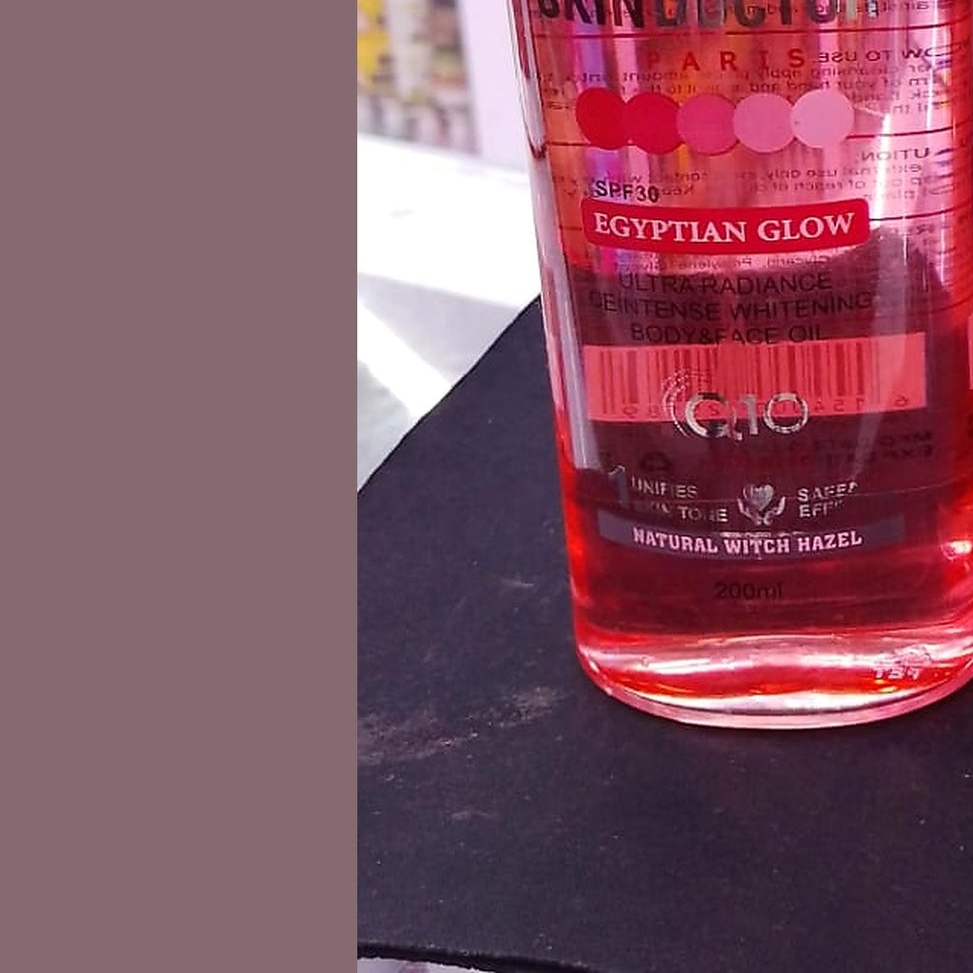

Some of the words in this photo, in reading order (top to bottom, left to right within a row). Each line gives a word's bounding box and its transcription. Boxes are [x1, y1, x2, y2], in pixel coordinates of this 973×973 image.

[646, 47, 806, 72] PARIS
[595, 180, 660, 204] SPF30
[593, 211, 748, 244] EGYPTIAN
[756, 212, 857, 243] GLOW
[618, 272, 696, 294] ULTRA
[697, 272, 834, 296] RADIANCE
[729, 293, 872, 320] WHITENING
[630, 323, 780, 346] BODY&FACE
[787, 324, 824, 343] OIL
[684, 391, 809, 444] Q10
[631, 474, 700, 501] UNIFIES
[632, 526, 719, 554] NATURAL
[723, 535, 791, 556] WITCH
[797, 530, 863, 553] HAZEL
[714, 580, 783, 601] 200ml
